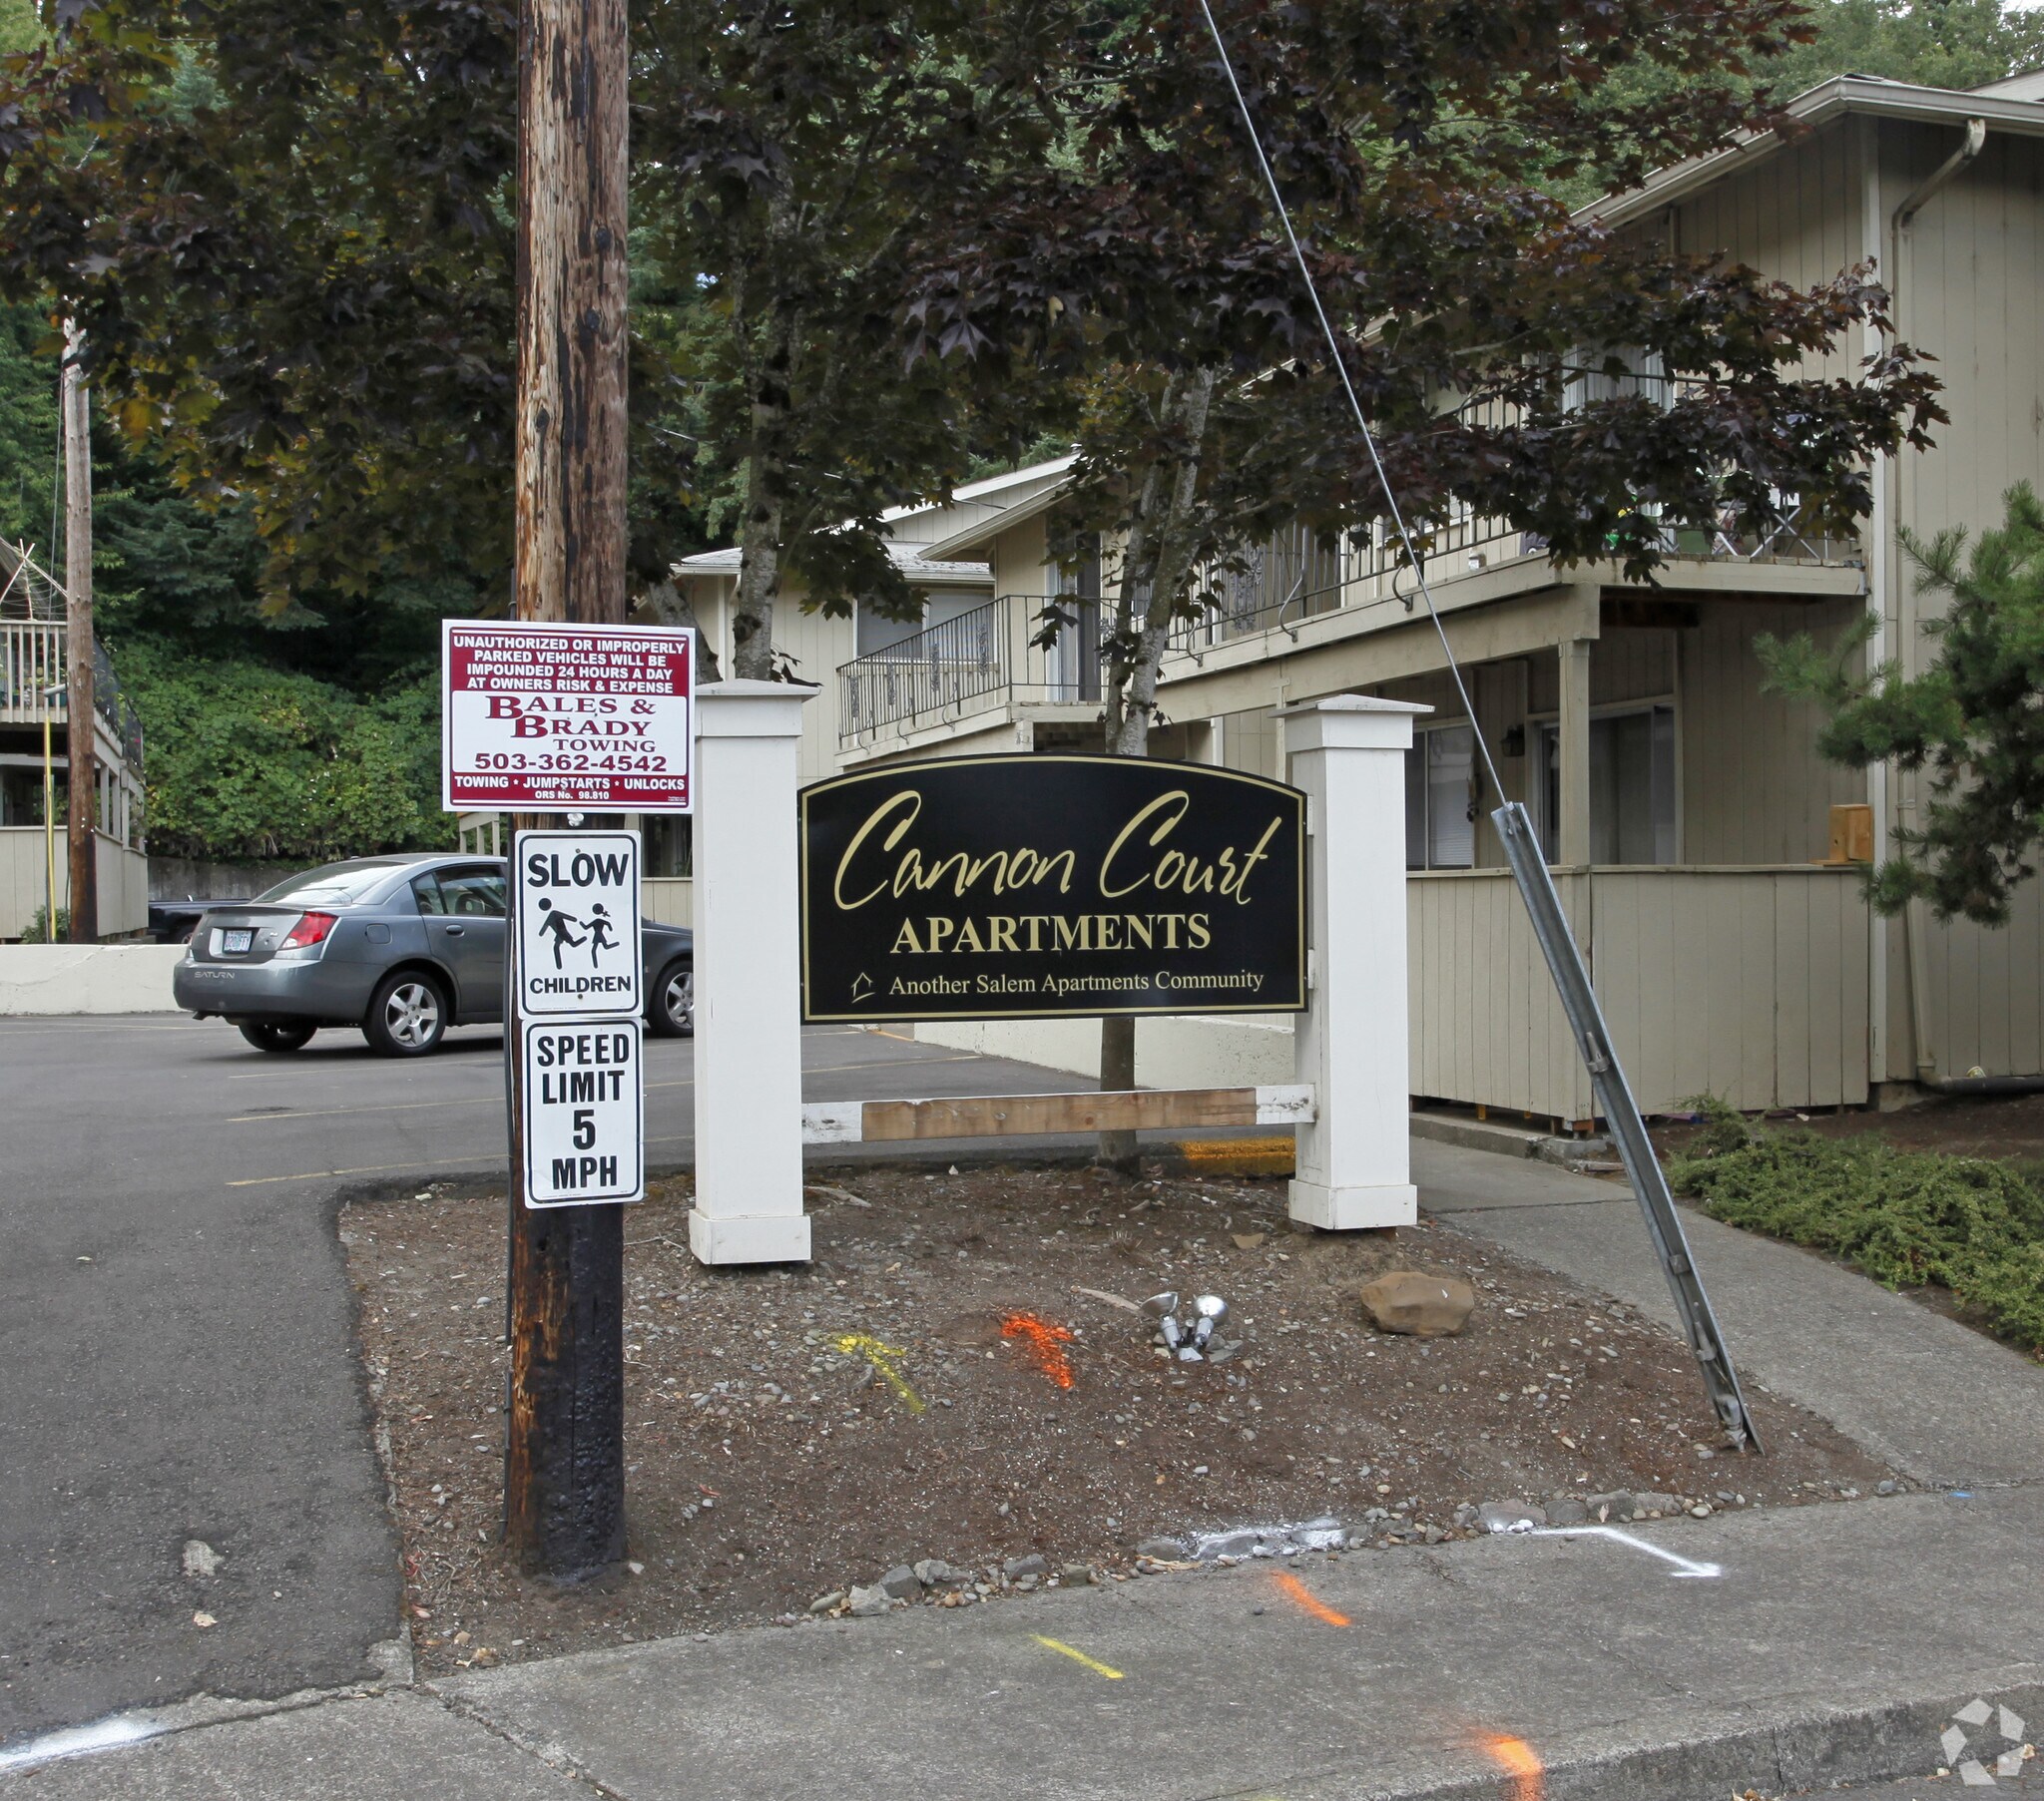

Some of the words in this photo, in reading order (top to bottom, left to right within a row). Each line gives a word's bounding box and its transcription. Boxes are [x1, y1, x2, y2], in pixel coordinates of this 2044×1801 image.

[454, 636, 569, 650] UNAUTHORIZED
[573, 640, 593, 651] OR
[597, 641, 685, 655] IMPROPERLY
[475, 651, 532, 663] PARKED
[538, 653, 606, 665] VEHICLES
[611, 655, 644, 667] WILL
[649, 656, 666, 667] BE
[467, 664, 554, 676] IMPOUNDED
[558, 667, 575, 677] 24
[580, 668, 629, 678] HOURS
[633, 669, 642, 679] A
[646, 670, 673, 680] DAY
[467, 678, 486, 688] AT
[490, 677, 552, 689] OWNERS
[557, 679, 590, 691] RISK
[595, 680, 605, 691] &
[610, 681, 673, 693] EXPENSE
[485, 696, 618, 718] BALES
[630, 699, 657, 714] &
[510, 715, 652, 738] BRADY
[553, 739, 656, 752] TOWING
[475, 753, 667, 772] 503-362-4542
[455, 776, 508, 787] TOWING
[523, 777, 610, 789] JUMPSTARTS
[624, 779, 685, 790] UNLOCKS
[834, 790, 1075, 910] Cannon
[1100, 790, 1282, 905] Court
[527, 853, 629, 887] SLOW
[890, 912, 1211, 954] APARTMENTS
[529, 976, 631, 994] CHILDREN
[889, 975, 970, 996] Another
[976, 974, 1036, 994] Salem
[1041, 971, 1149, 997] Apartments
[1156, 969, 1264, 991] Community
[536, 1033, 630, 1067] SPEED
[542, 1070, 625, 1105] LIMIT
[573, 1109, 596, 1149] 5
[552, 1155, 617, 1190] MPH
